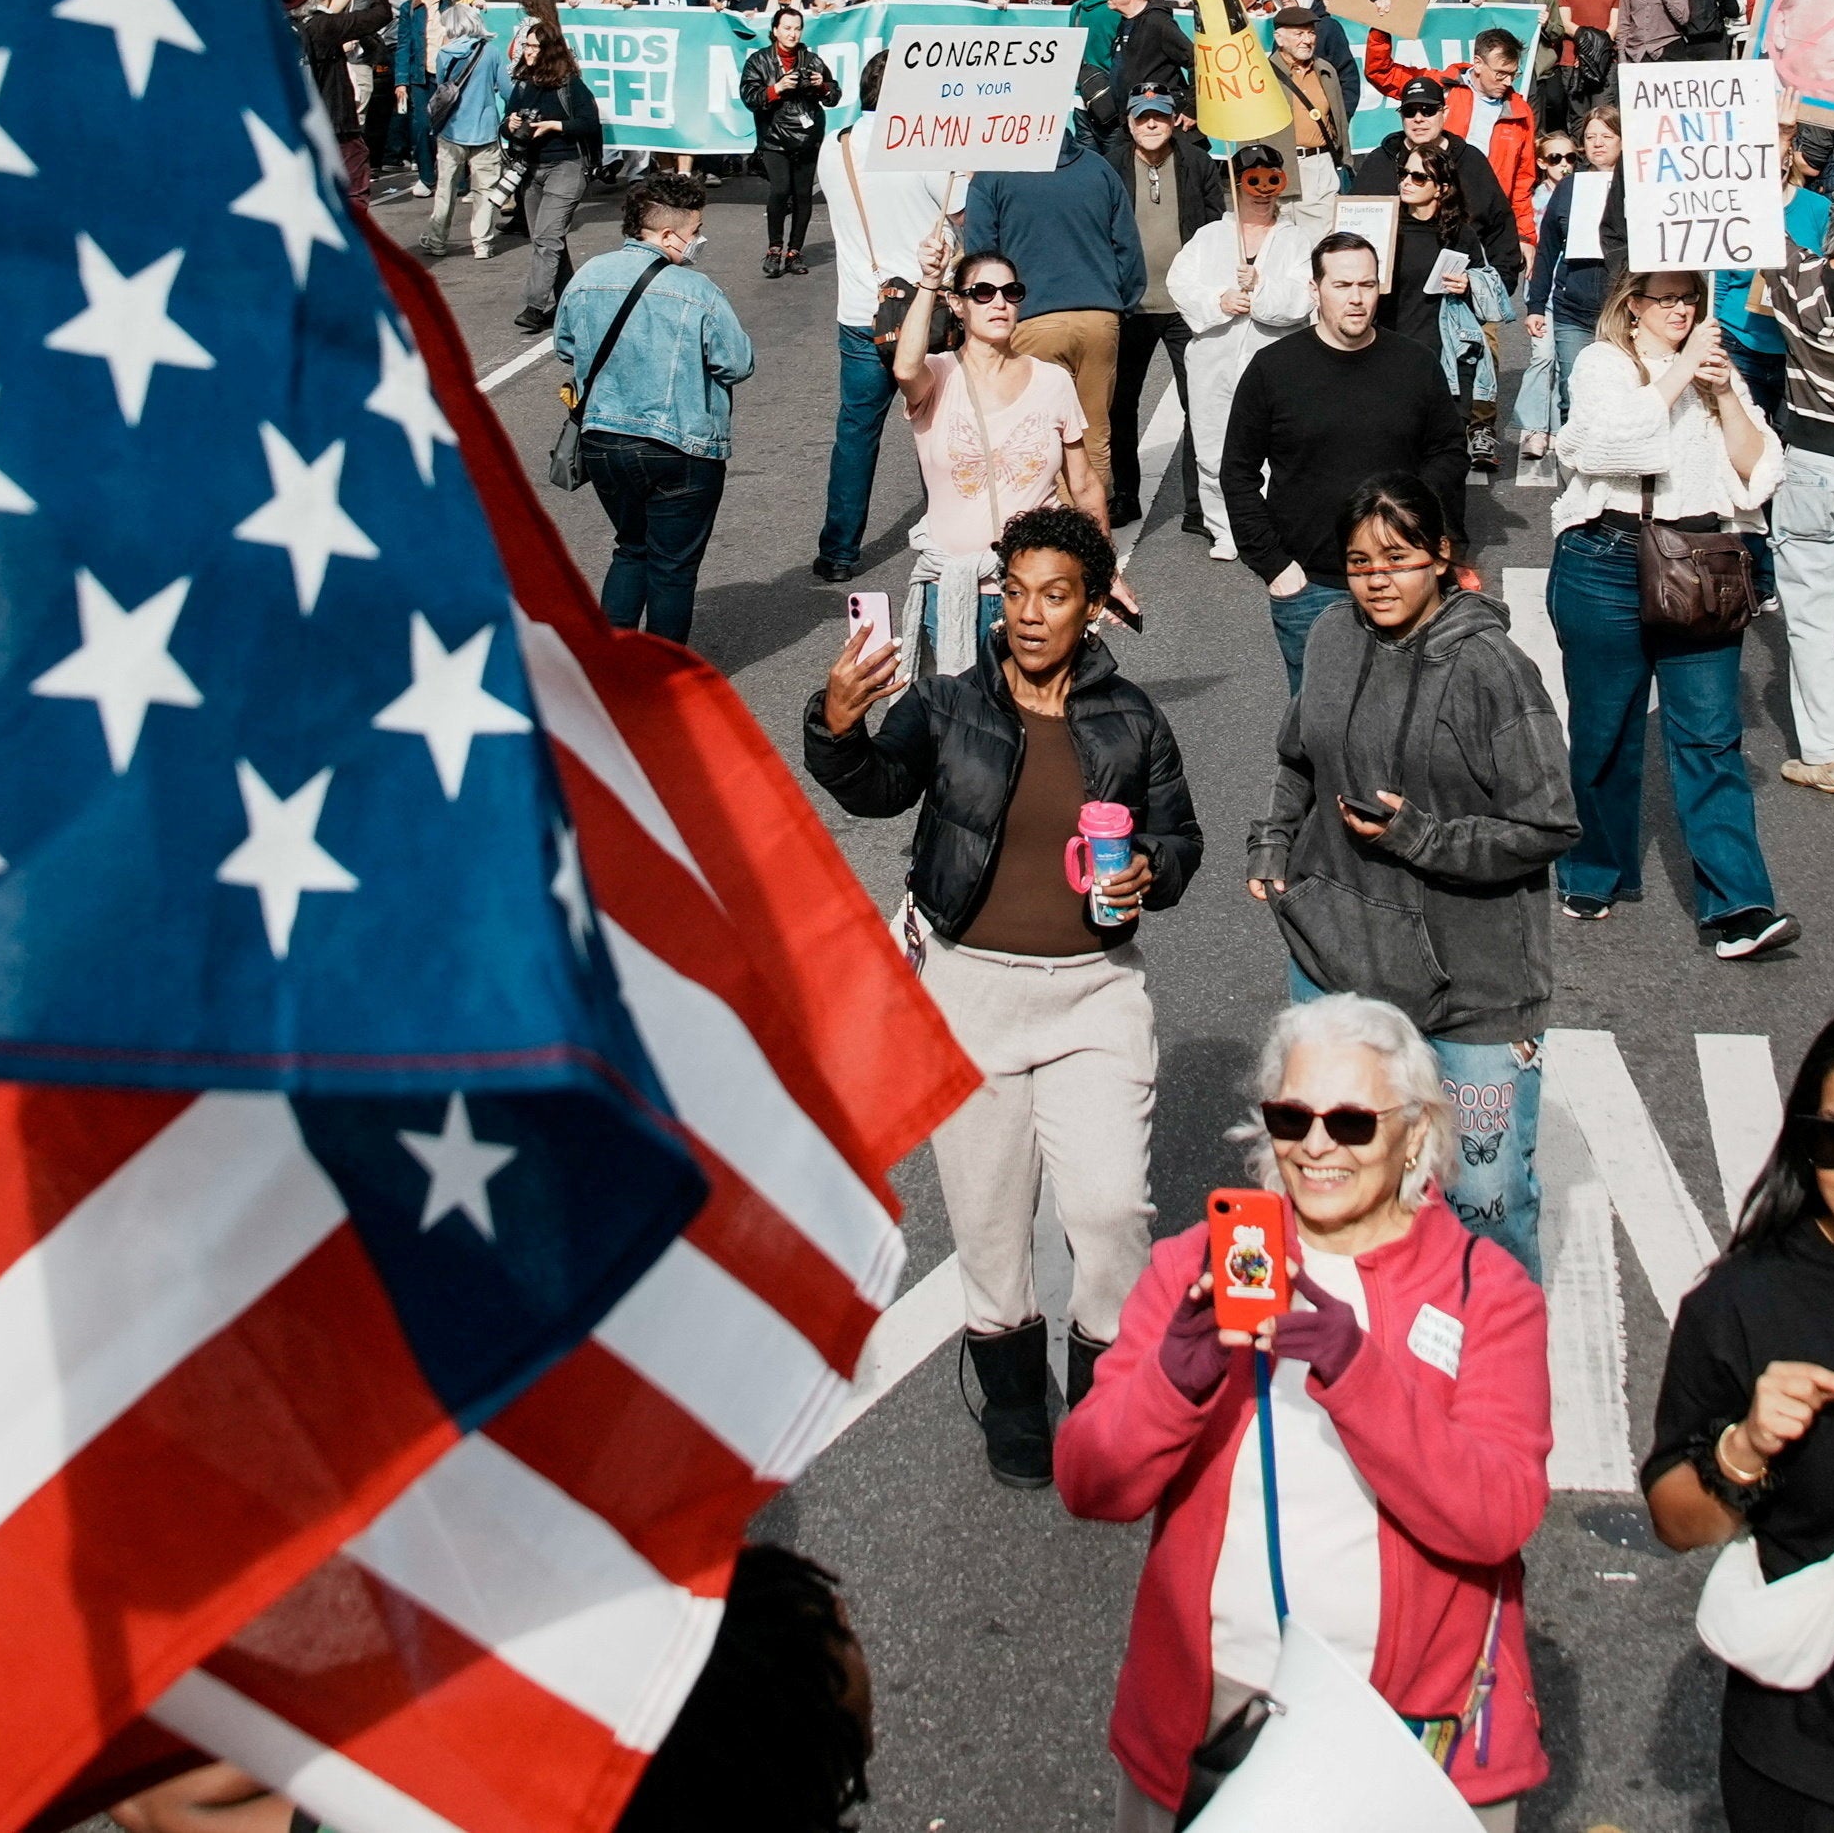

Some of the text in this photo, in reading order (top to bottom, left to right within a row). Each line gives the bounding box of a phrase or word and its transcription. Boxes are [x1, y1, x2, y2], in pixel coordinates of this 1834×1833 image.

[566, 32, 669, 64] ANDS
[904, 40, 1058, 69] CONGRESS
[941, 82, 1012, 98] DO YOUR
[886, 114, 1056, 150] DAMN JOB!!
[1636, 143, 1775, 182] FASCIST
[1341, 206, 1383, 216] The justices
[1662, 189, 1742, 217] SINCE
[1657, 217, 1753, 262] 1776
[1442, 1078, 1515, 1111] GOOD
[1457, 1109, 1510, 1134] UCK
